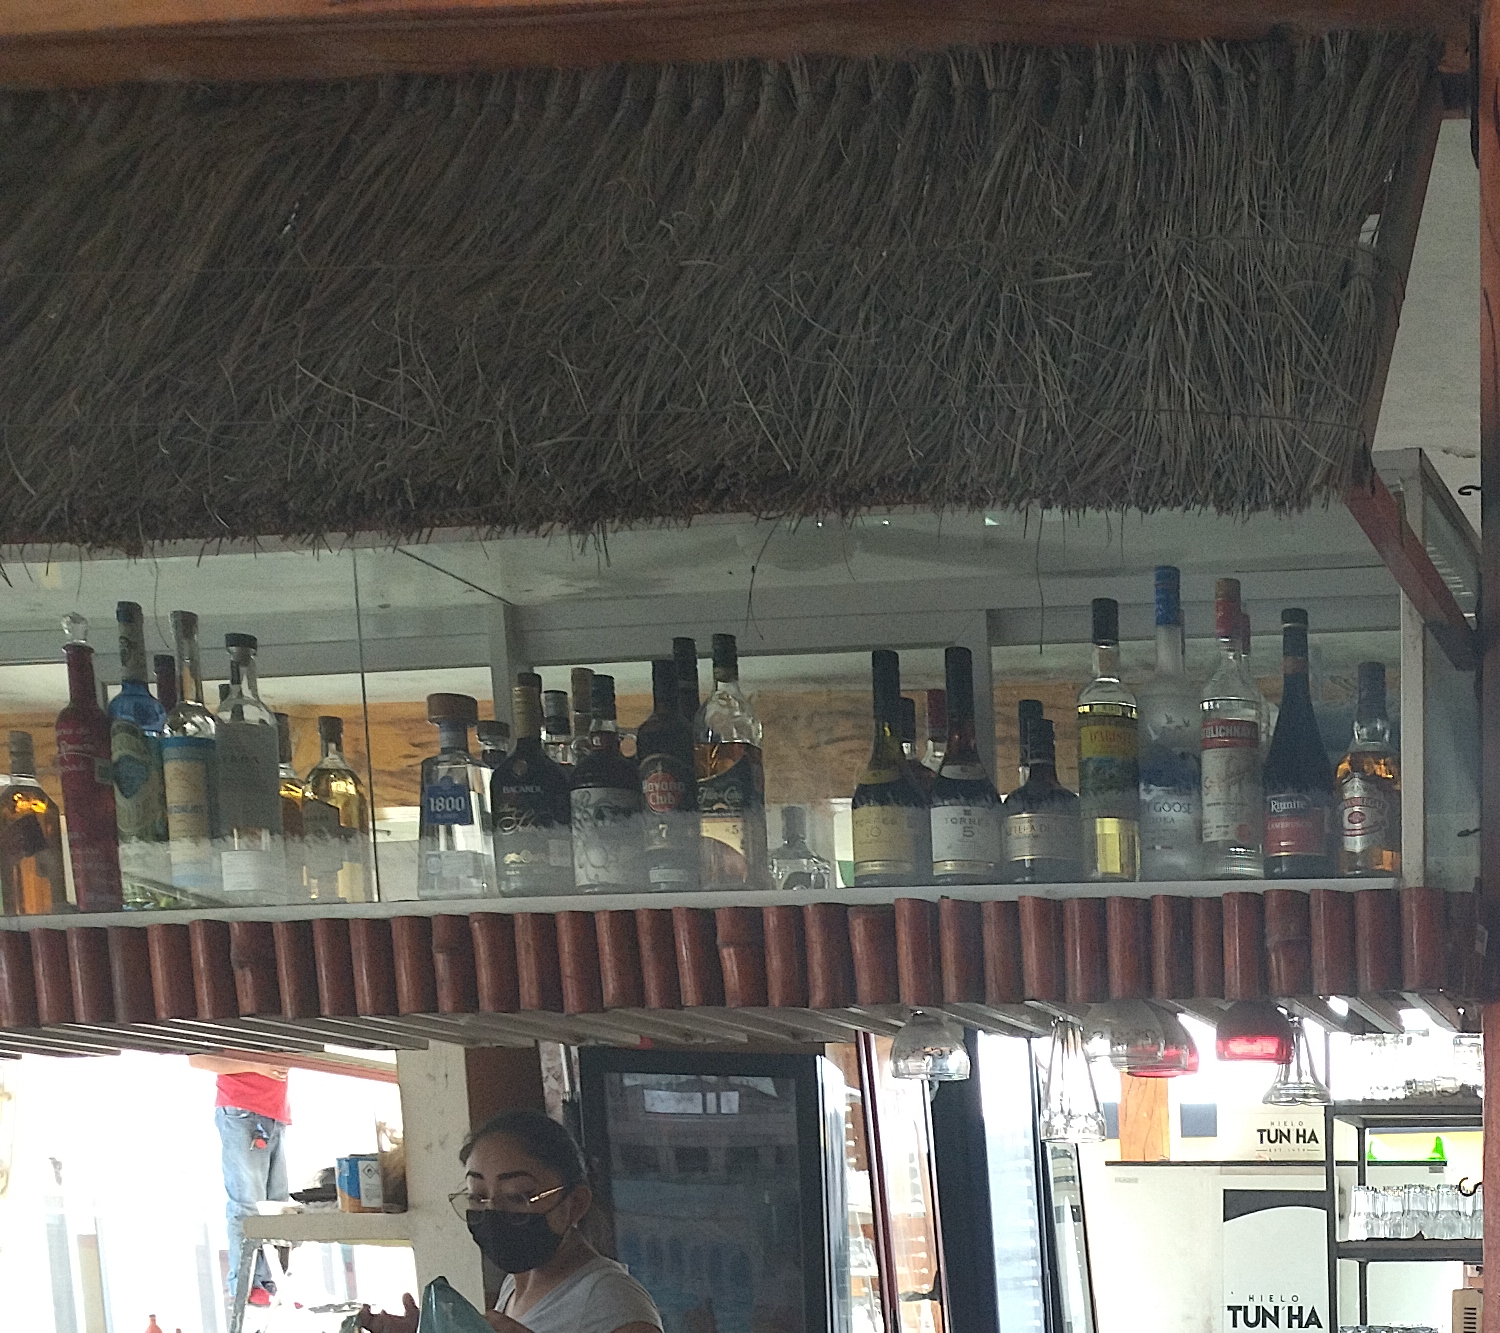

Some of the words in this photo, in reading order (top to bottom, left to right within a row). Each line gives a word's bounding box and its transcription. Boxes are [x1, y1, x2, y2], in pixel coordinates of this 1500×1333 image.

[430, 796, 466, 812] 1800
[649, 792, 676, 805] Club
[1154, 802, 1193, 814] GOOSE
[658, 824, 669, 838] 7
[962, 827, 975, 838] 5
[1248, 1294, 1299, 1302] HIELO
